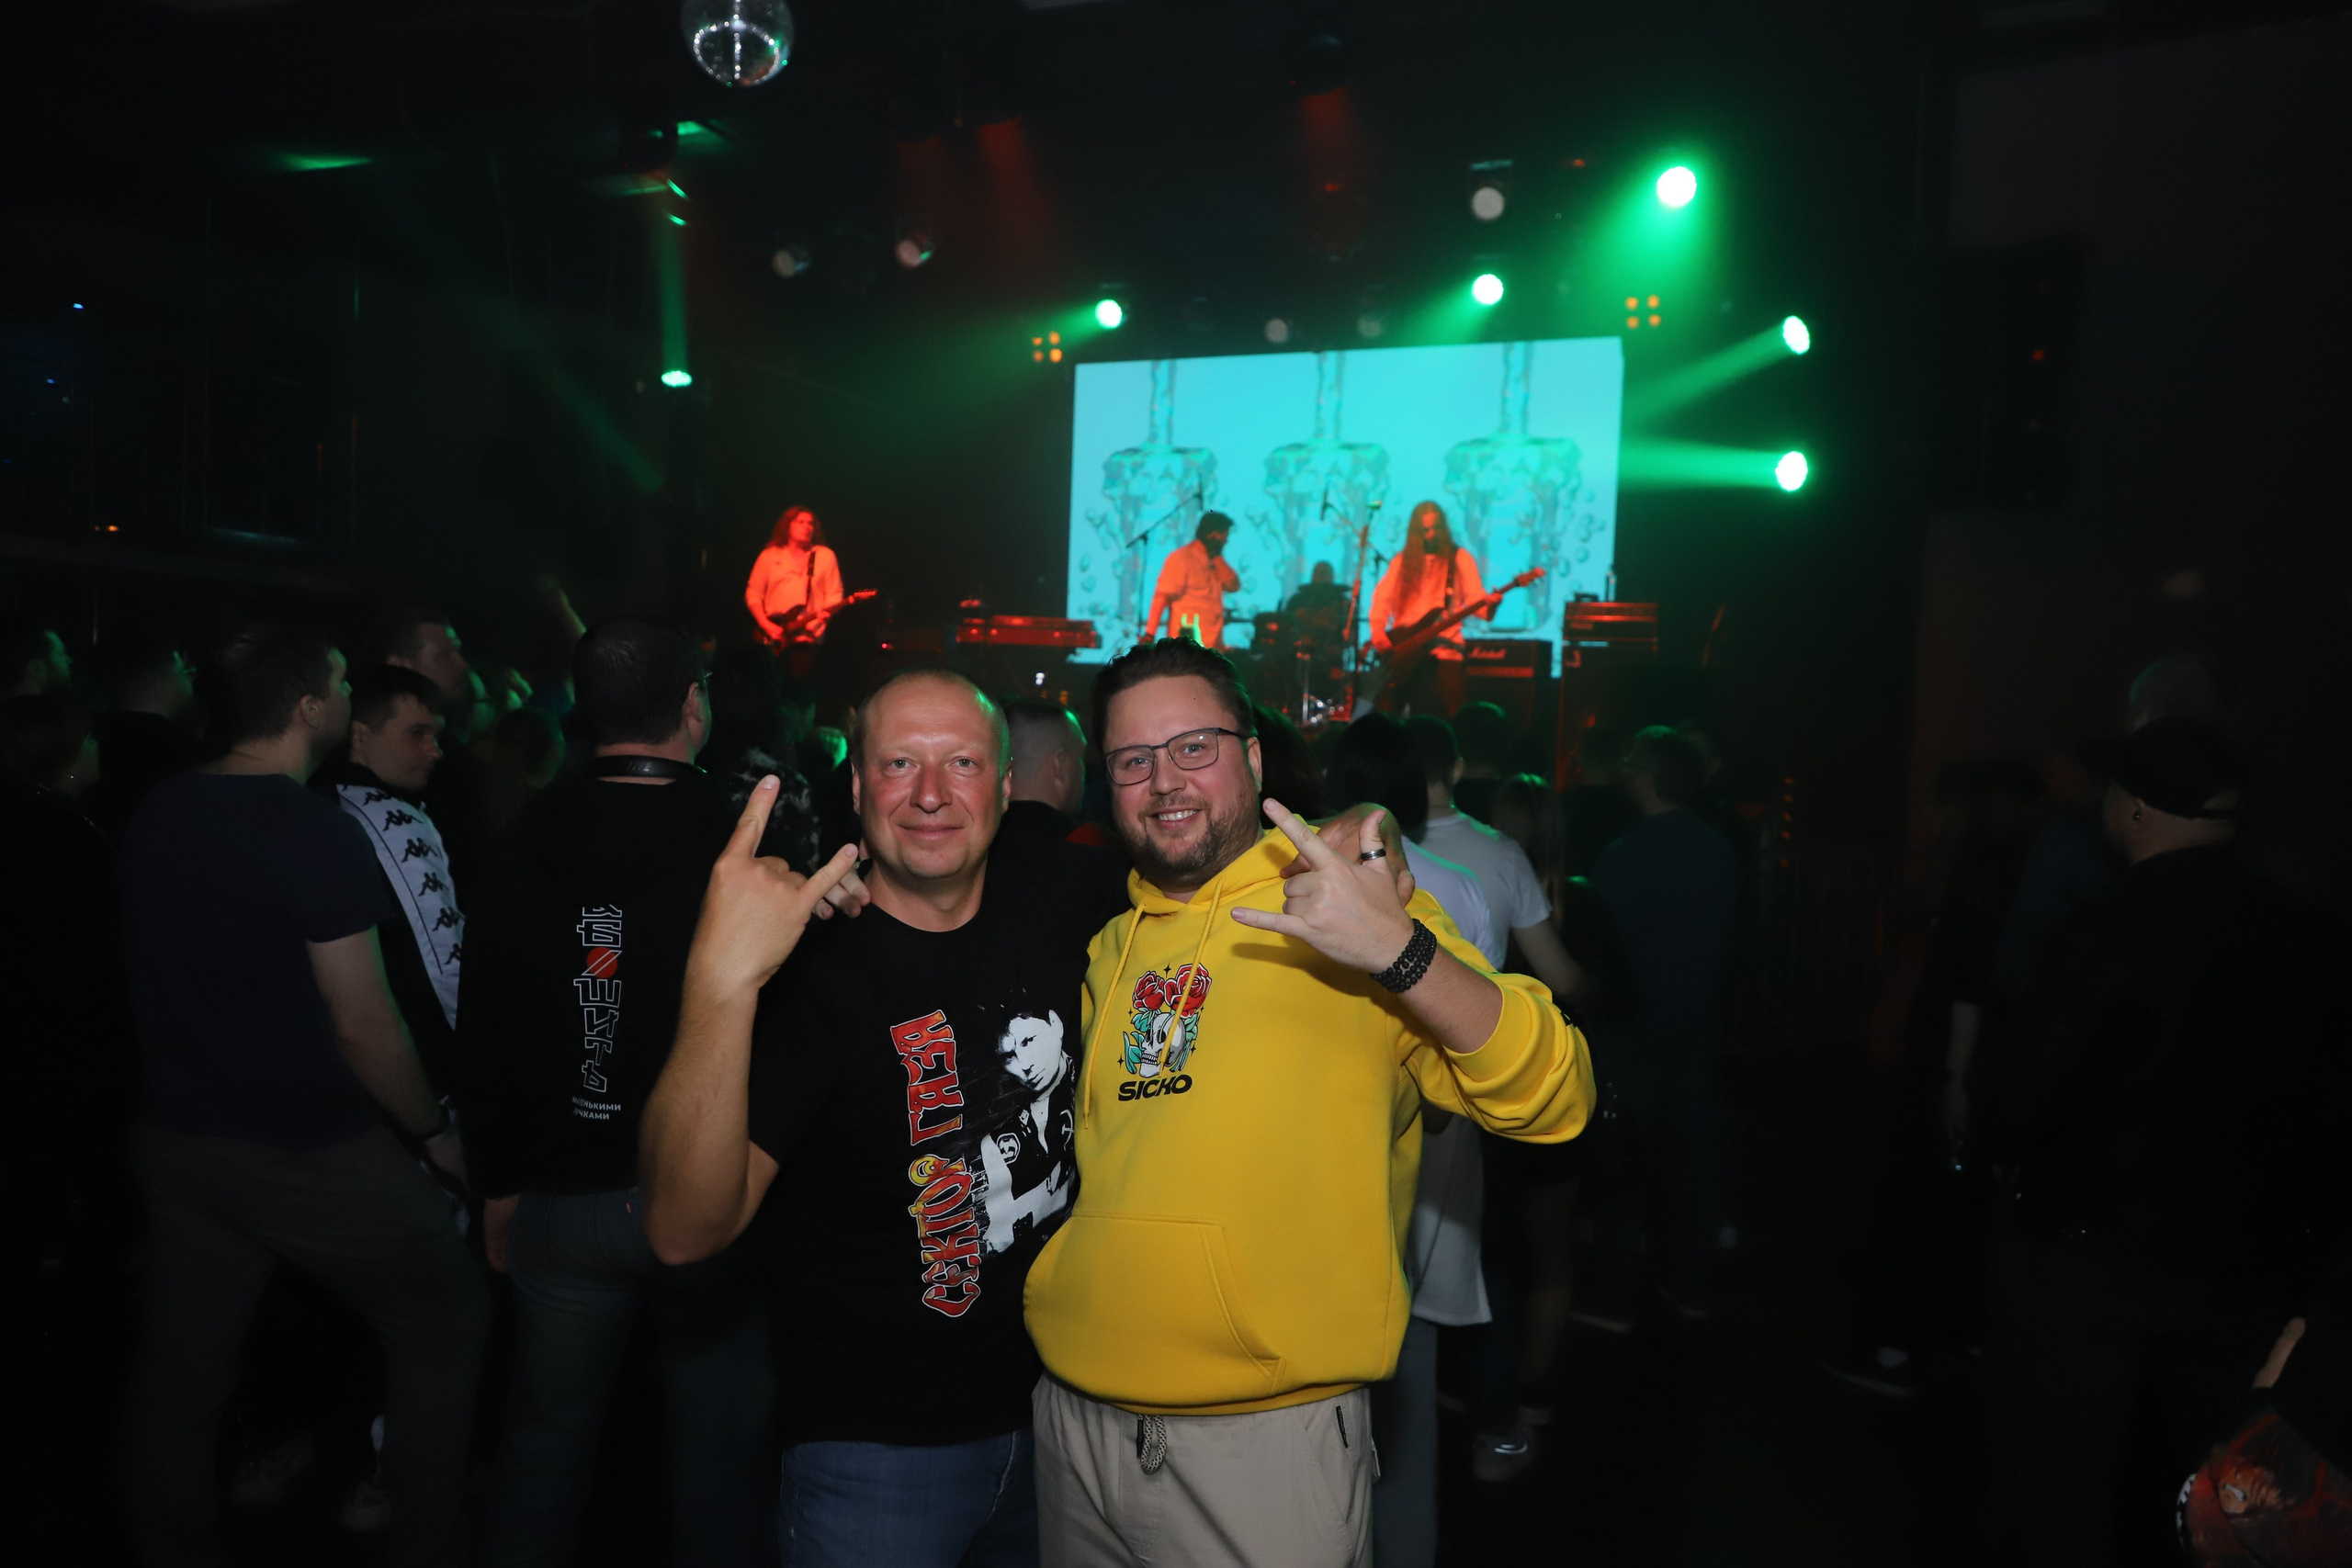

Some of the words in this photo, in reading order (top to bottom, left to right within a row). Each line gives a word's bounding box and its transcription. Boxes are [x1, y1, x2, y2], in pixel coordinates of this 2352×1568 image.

[889, 1009, 965, 1146] ГАЗА
[1118, 1075, 1193, 1101] SICKO
[909, 1154, 981, 1317] СЕКТОР
